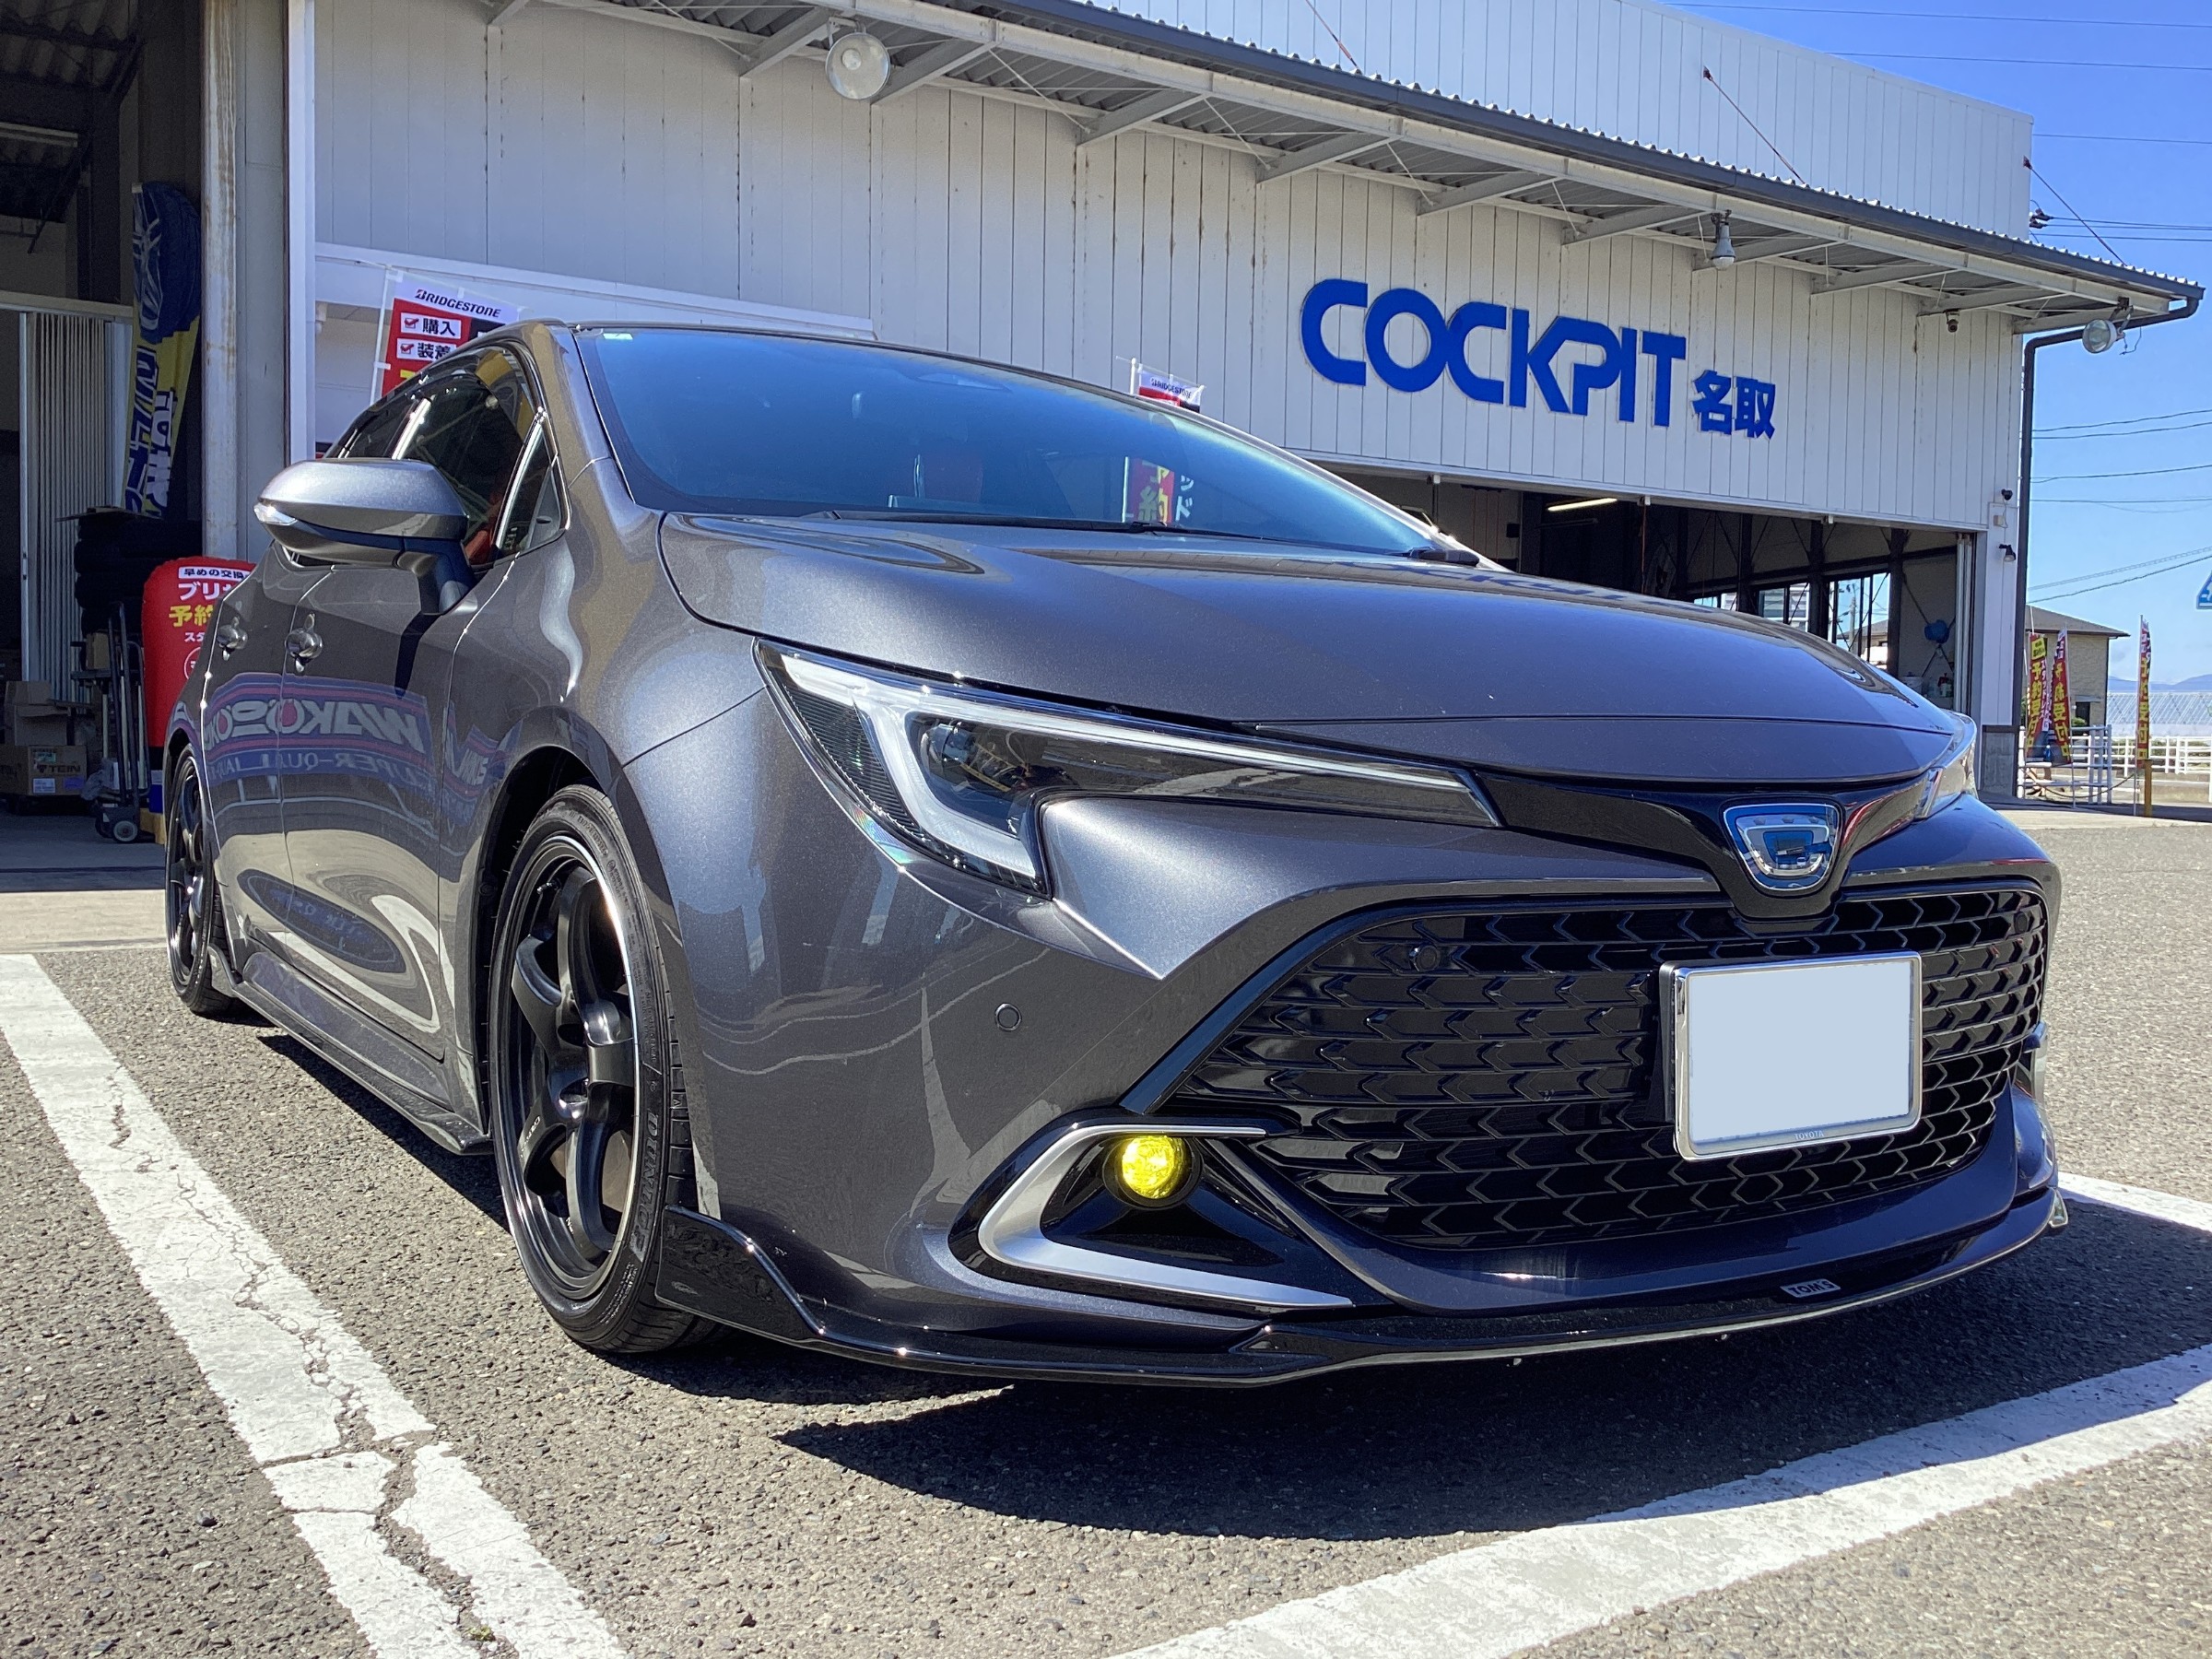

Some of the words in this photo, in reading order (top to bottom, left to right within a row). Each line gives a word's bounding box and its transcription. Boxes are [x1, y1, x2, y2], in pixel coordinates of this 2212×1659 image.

[415, 288, 501, 318] BRIDGESTONE
[422, 317, 456, 336] 購入
[1300, 278, 1687, 428] COCKPIT
[1692, 370, 1776, 440] 名取
[48, 764, 81, 773] TEIN
[1794, 1129, 1825, 1141] TOYOTA
[1788, 1279, 1835, 1298] TOM'S
